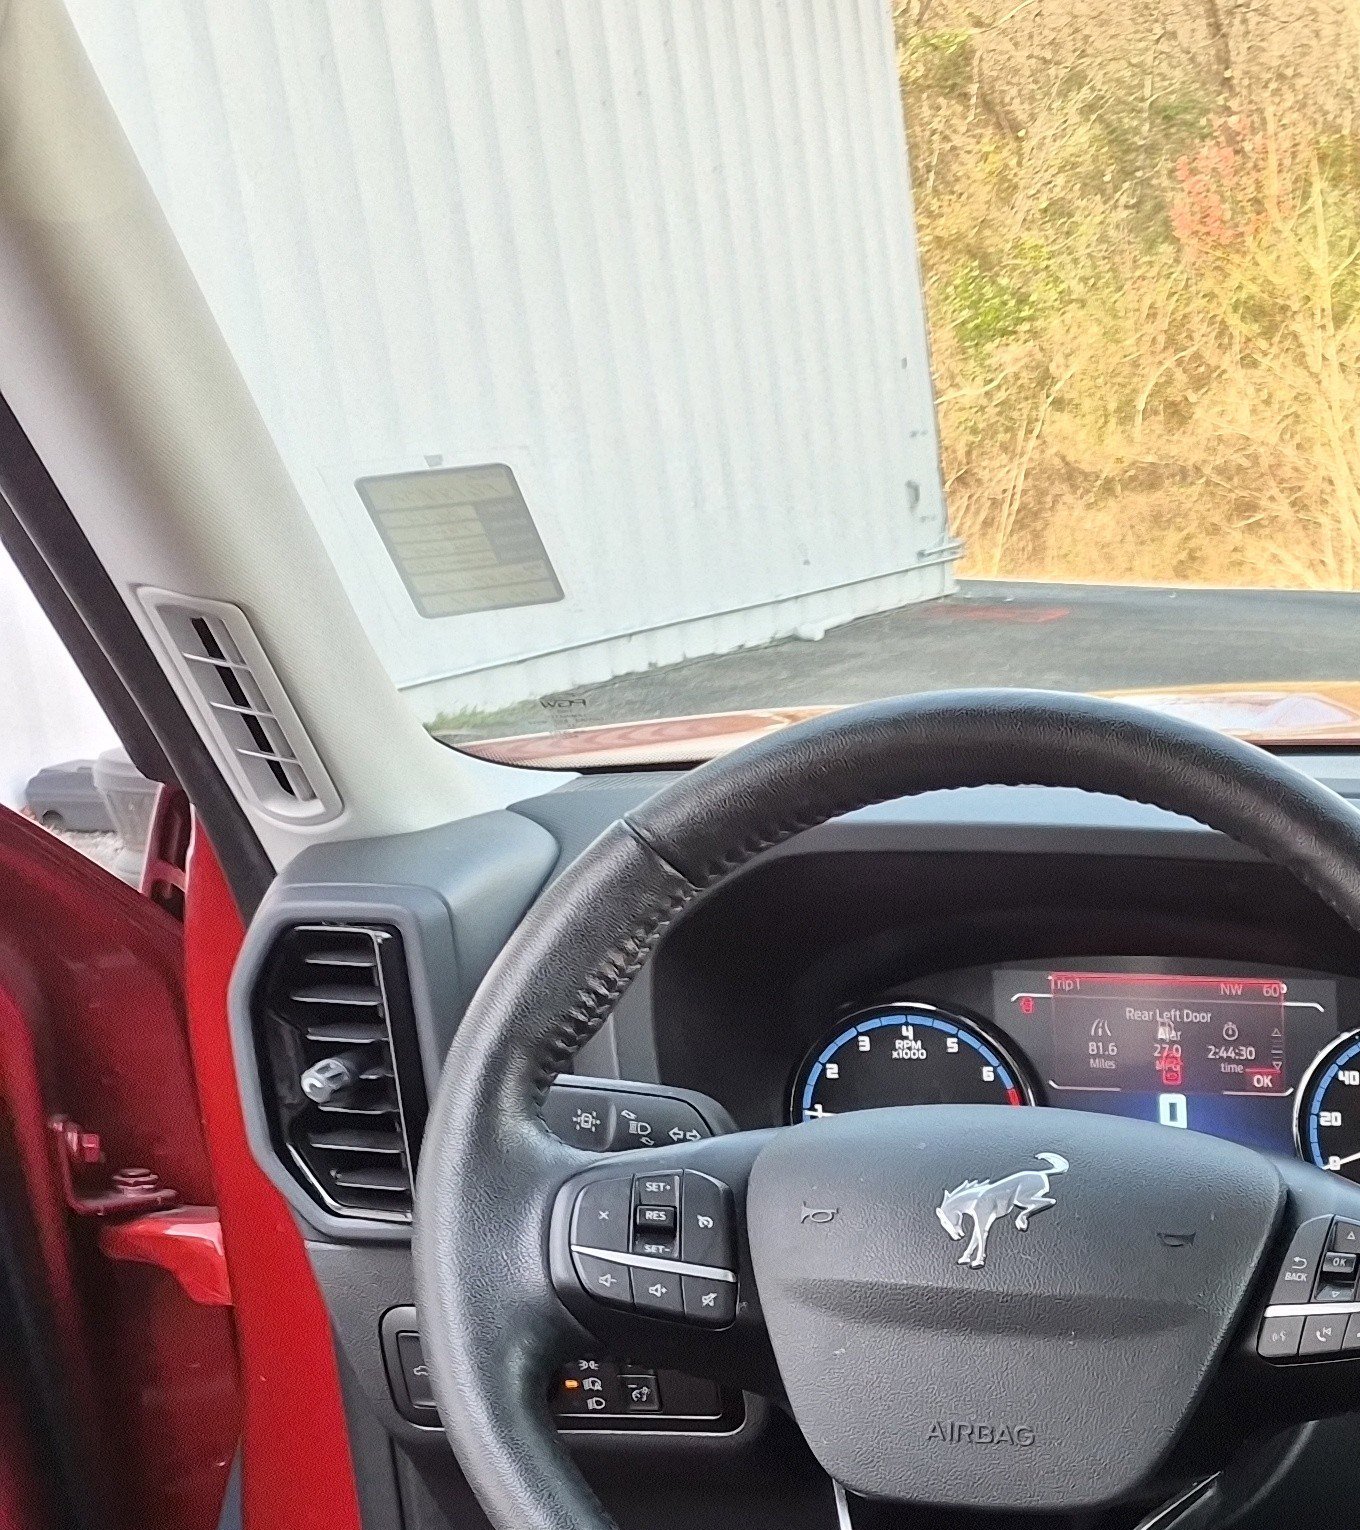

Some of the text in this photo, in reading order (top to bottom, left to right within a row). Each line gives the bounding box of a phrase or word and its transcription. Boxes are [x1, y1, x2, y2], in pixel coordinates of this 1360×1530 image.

[1220, 983, 1243, 996] NW
[1126, 1007, 1212, 1023] Rear Left Door
[902, 1025, 913, 1039] 4
[1158, 1027, 1182, 1041] Ajar
[858, 1036, 870, 1051] 3
[895, 1040, 922, 1050] RPM
[947, 1037, 959, 1053] 5
[1088, 1042, 1117, 1056] 81.6
[892, 1050, 927, 1060] x1000
[1207, 1046, 1256, 1060] 2:44:30
[826, 1063, 839, 1079] 2
[1090, 1059, 1116, 1069] Miles
[1221, 1062, 1244, 1073] time
[982, 1066, 994, 1082] 6
[1338, 1070, 1360, 1085] 40
[1253, 1075, 1273, 1088] OK
[1319, 1112, 1342, 1126] 20
[646, 1182, 671, 1192] SET+
[645, 1211, 667, 1221] RES
[1332, 1257, 1347, 1267] OK
[1285, 1272, 1308, 1282] BACK
[926, 1420, 1036, 1448] AIRBAG
